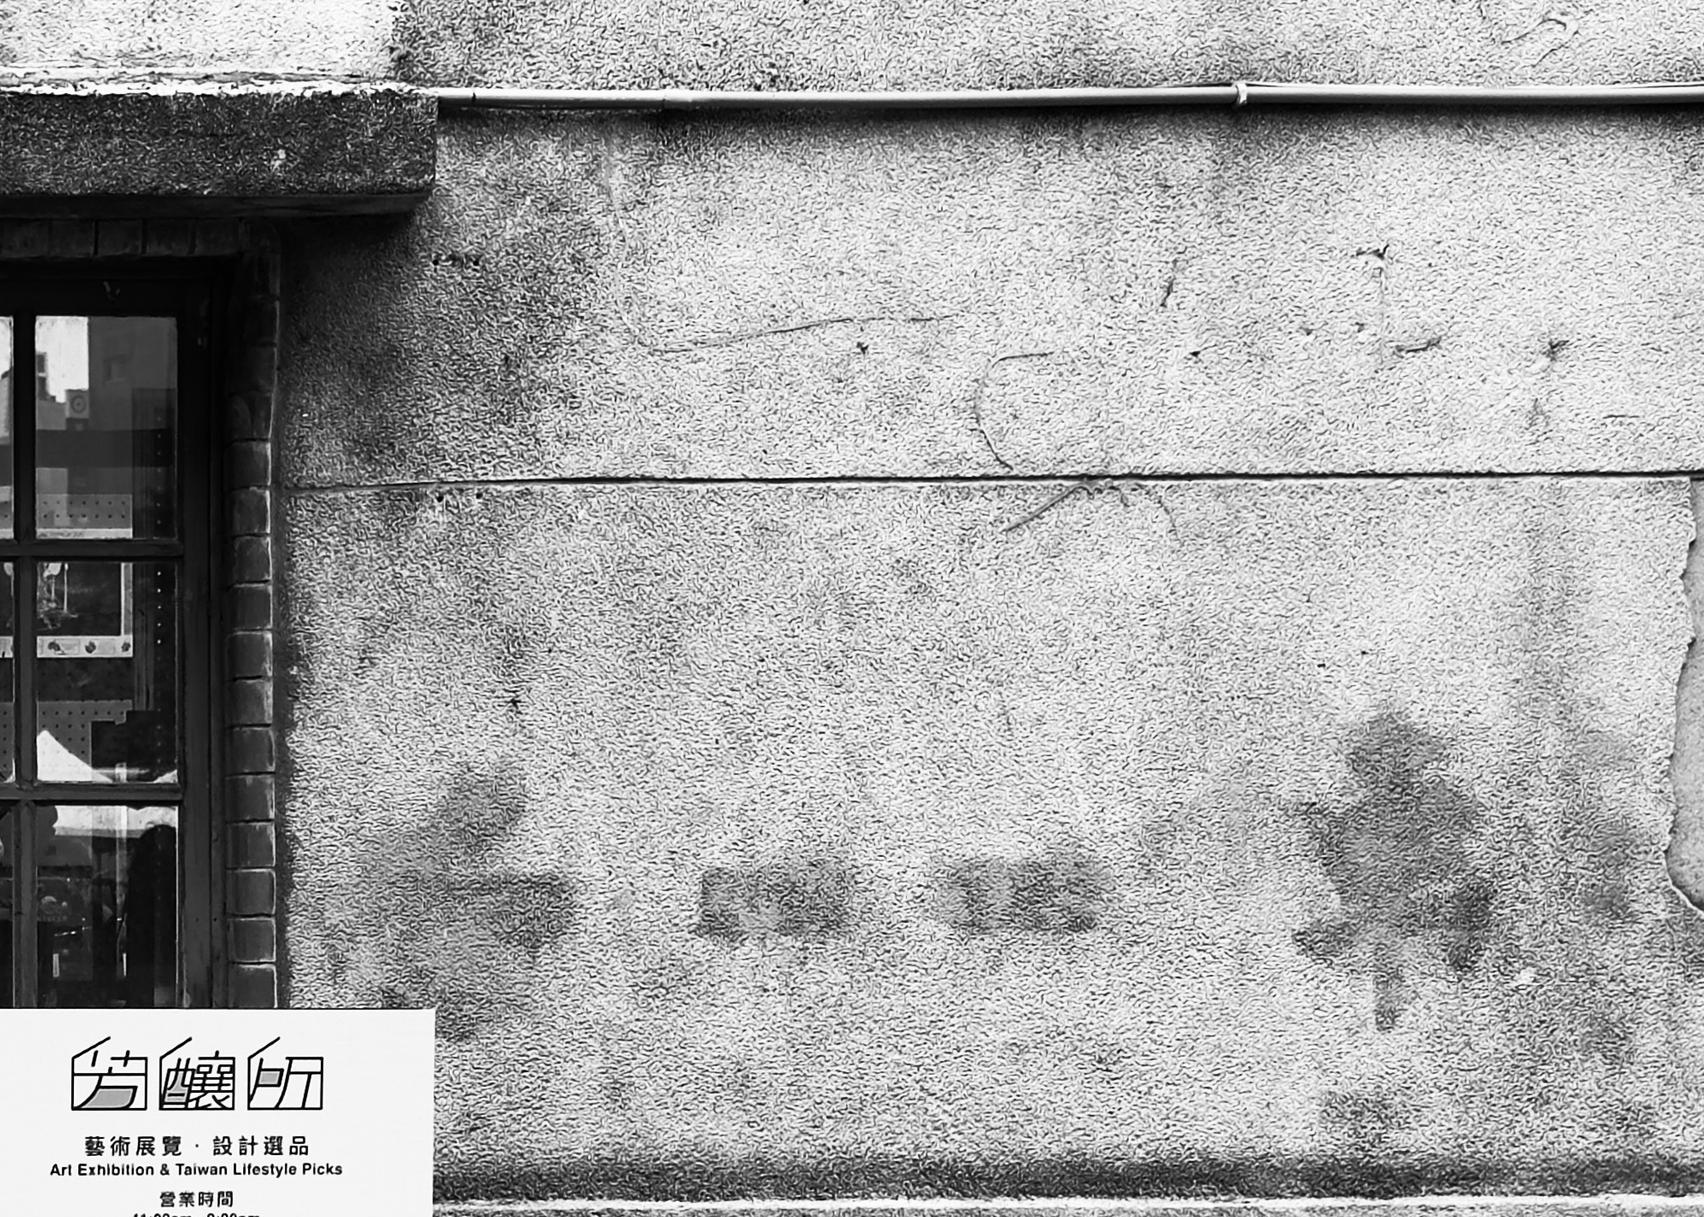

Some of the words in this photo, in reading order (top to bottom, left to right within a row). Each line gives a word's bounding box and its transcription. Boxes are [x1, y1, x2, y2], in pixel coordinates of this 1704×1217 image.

[84, 1135, 182, 1157] 藝術展覽
[212, 1135, 309, 1157] 設計選品
[49, 1163, 72, 1177] Art
[77, 1162, 155, 1177] Exhibition
[159, 1163, 170, 1176] &
[175, 1162, 228, 1176] Taiwan
[233, 1162, 298, 1179] Lifestyle
[302, 1162, 343, 1176] Picks
[159, 1190, 234, 1208] 營業時間
